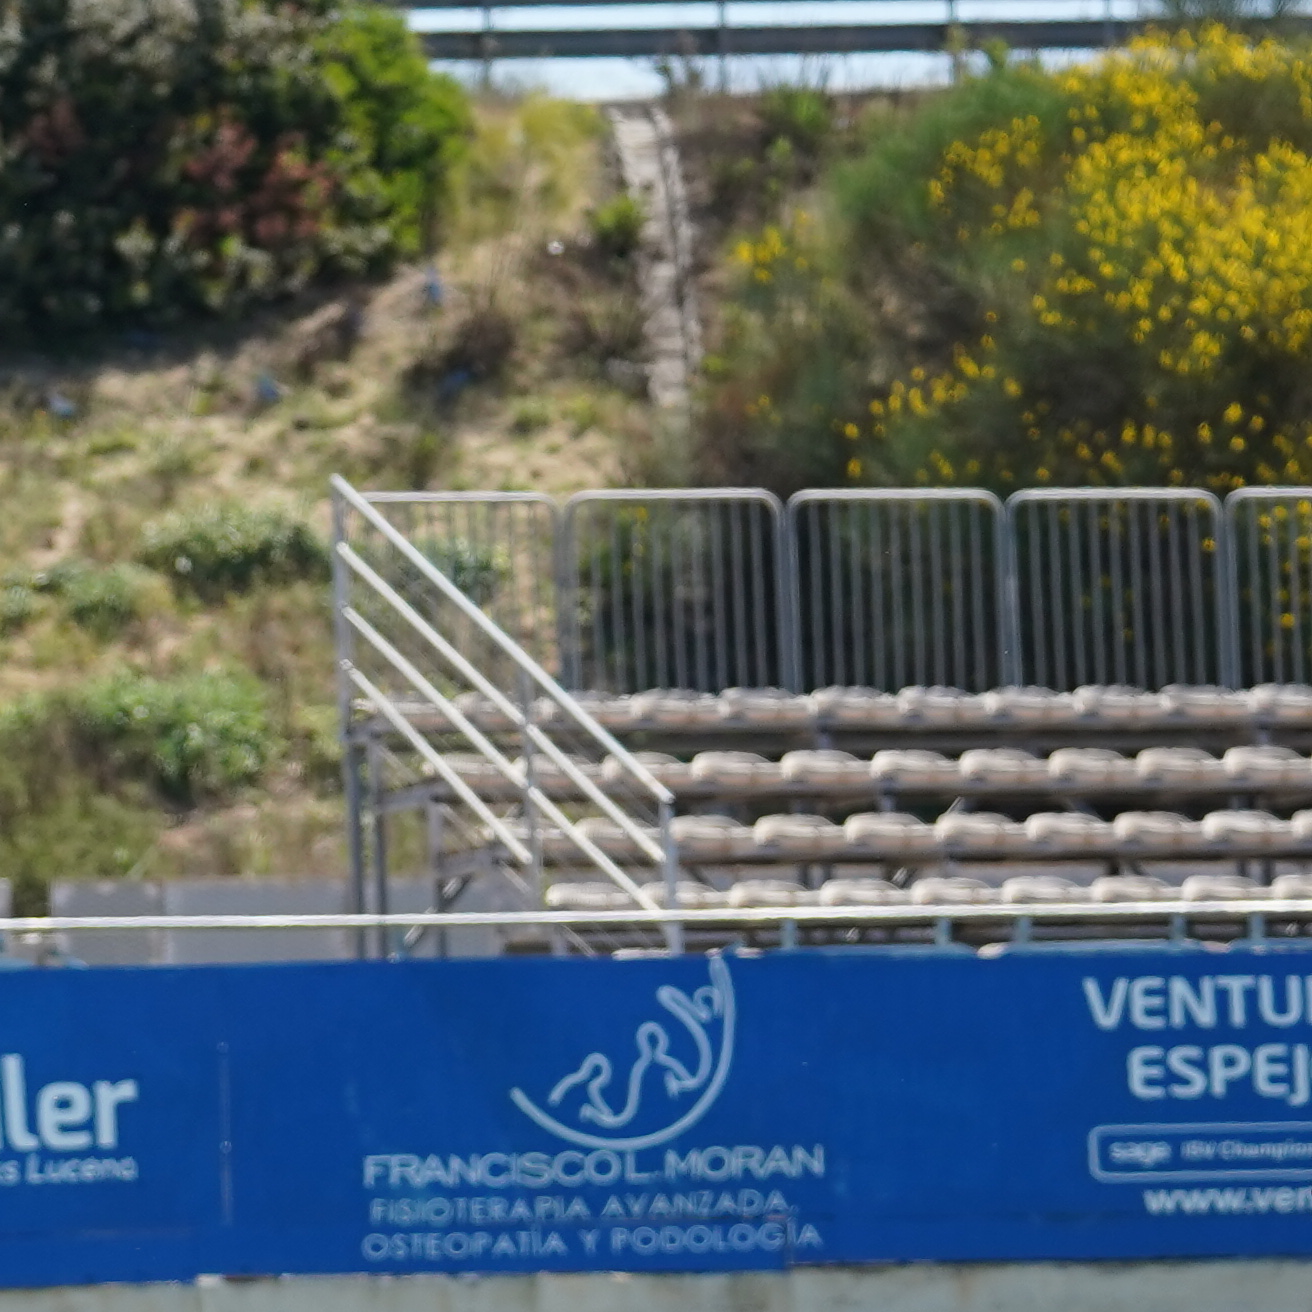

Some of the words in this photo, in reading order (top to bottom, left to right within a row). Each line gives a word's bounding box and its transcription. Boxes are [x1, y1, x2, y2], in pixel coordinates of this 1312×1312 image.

[1081, 974, 1312, 1031] VENTU
[1128, 1043, 1312, 1107] ESPEJ
[27, 1152, 139, 1184] Lucena
[362, 1149, 623, 1189] FRANCISCO
[664, 1143, 826, 1182] MORAN
[370, 1194, 590, 1227] FISIOTERAPIA
[579, 1227, 599, 1254] Y
